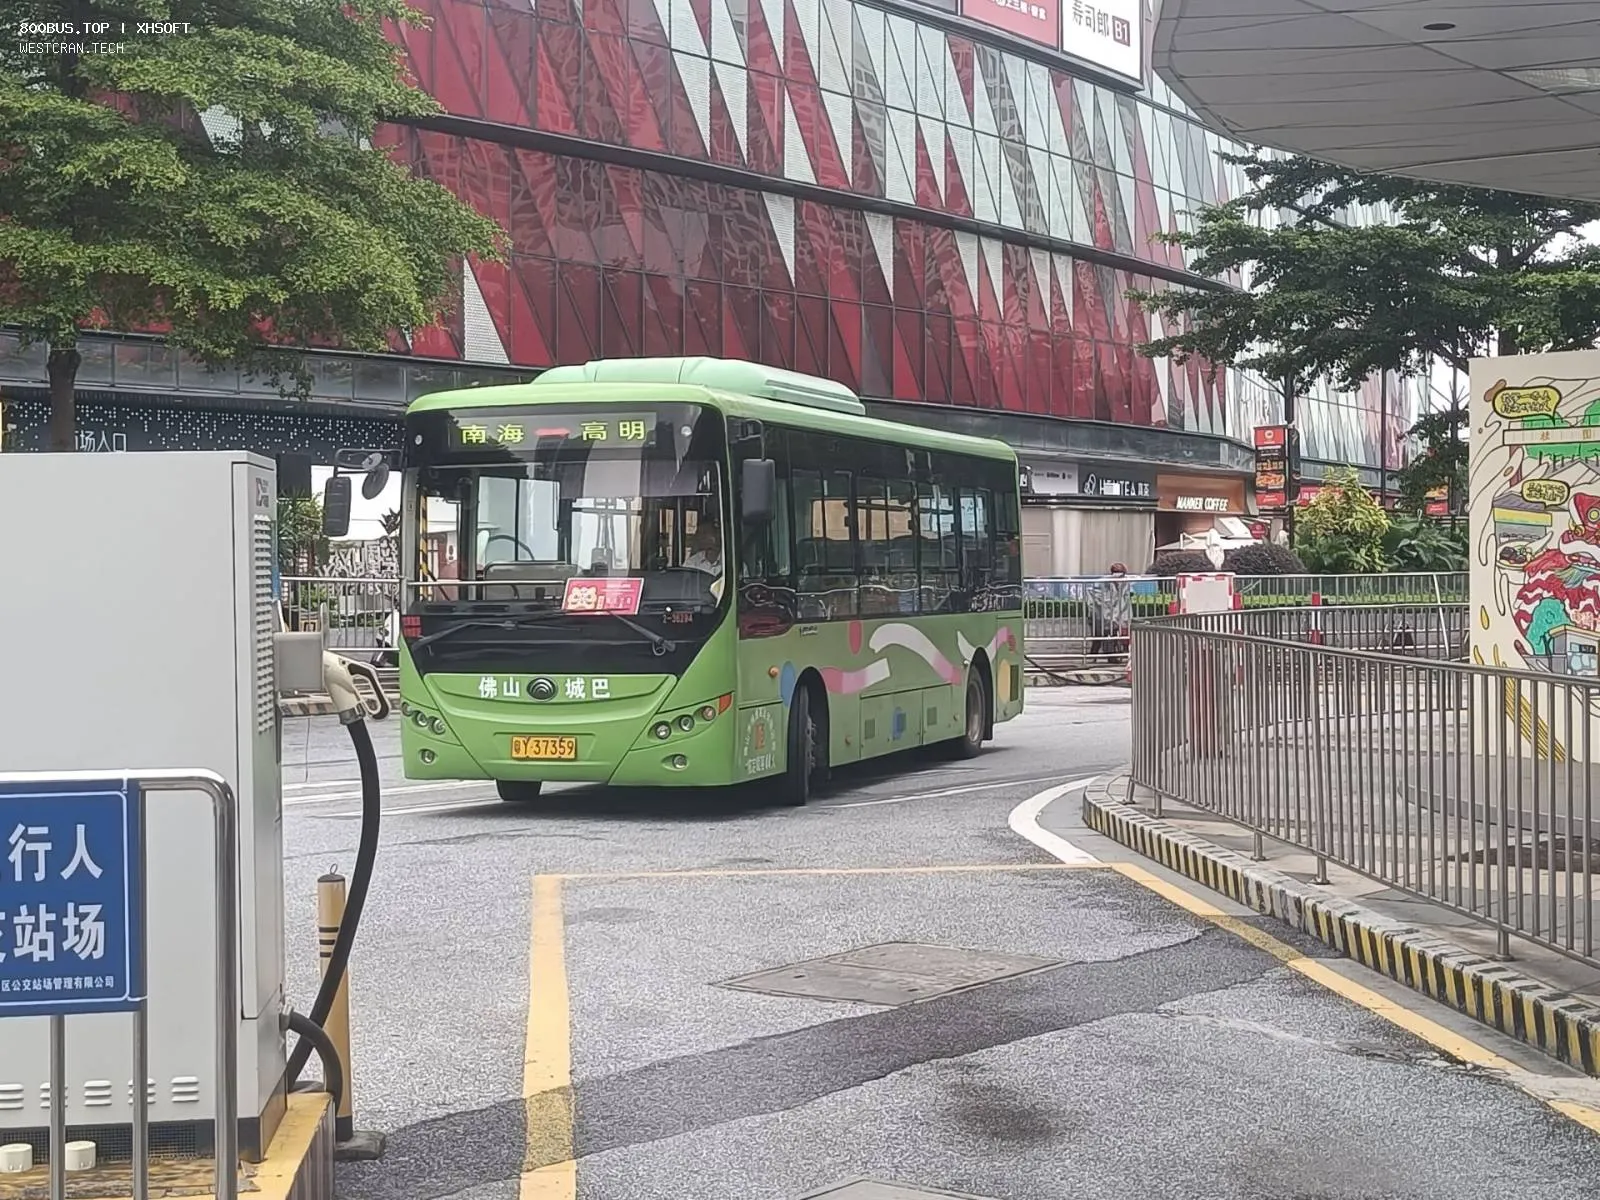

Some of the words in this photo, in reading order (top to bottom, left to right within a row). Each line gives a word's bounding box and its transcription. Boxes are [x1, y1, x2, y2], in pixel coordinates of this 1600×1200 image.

[1072, 0, 1109, 37] 寿司郎
[1115, 20, 1128, 43] B1
[74, 430, 126, 452] 场入口
[461, 424, 524, 443] 南海
[581, 421, 645, 440] 高明
[1204, 498, 1228, 511] COFFEE
[479, 677, 520, 698] 佛山
[565, 678, 610, 699] 城巴
[8, 823, 103, 881] 行人
[0, 903, 105, 962] 站场
[1, 976, 114, 992] 区公交站场管理有限公司
